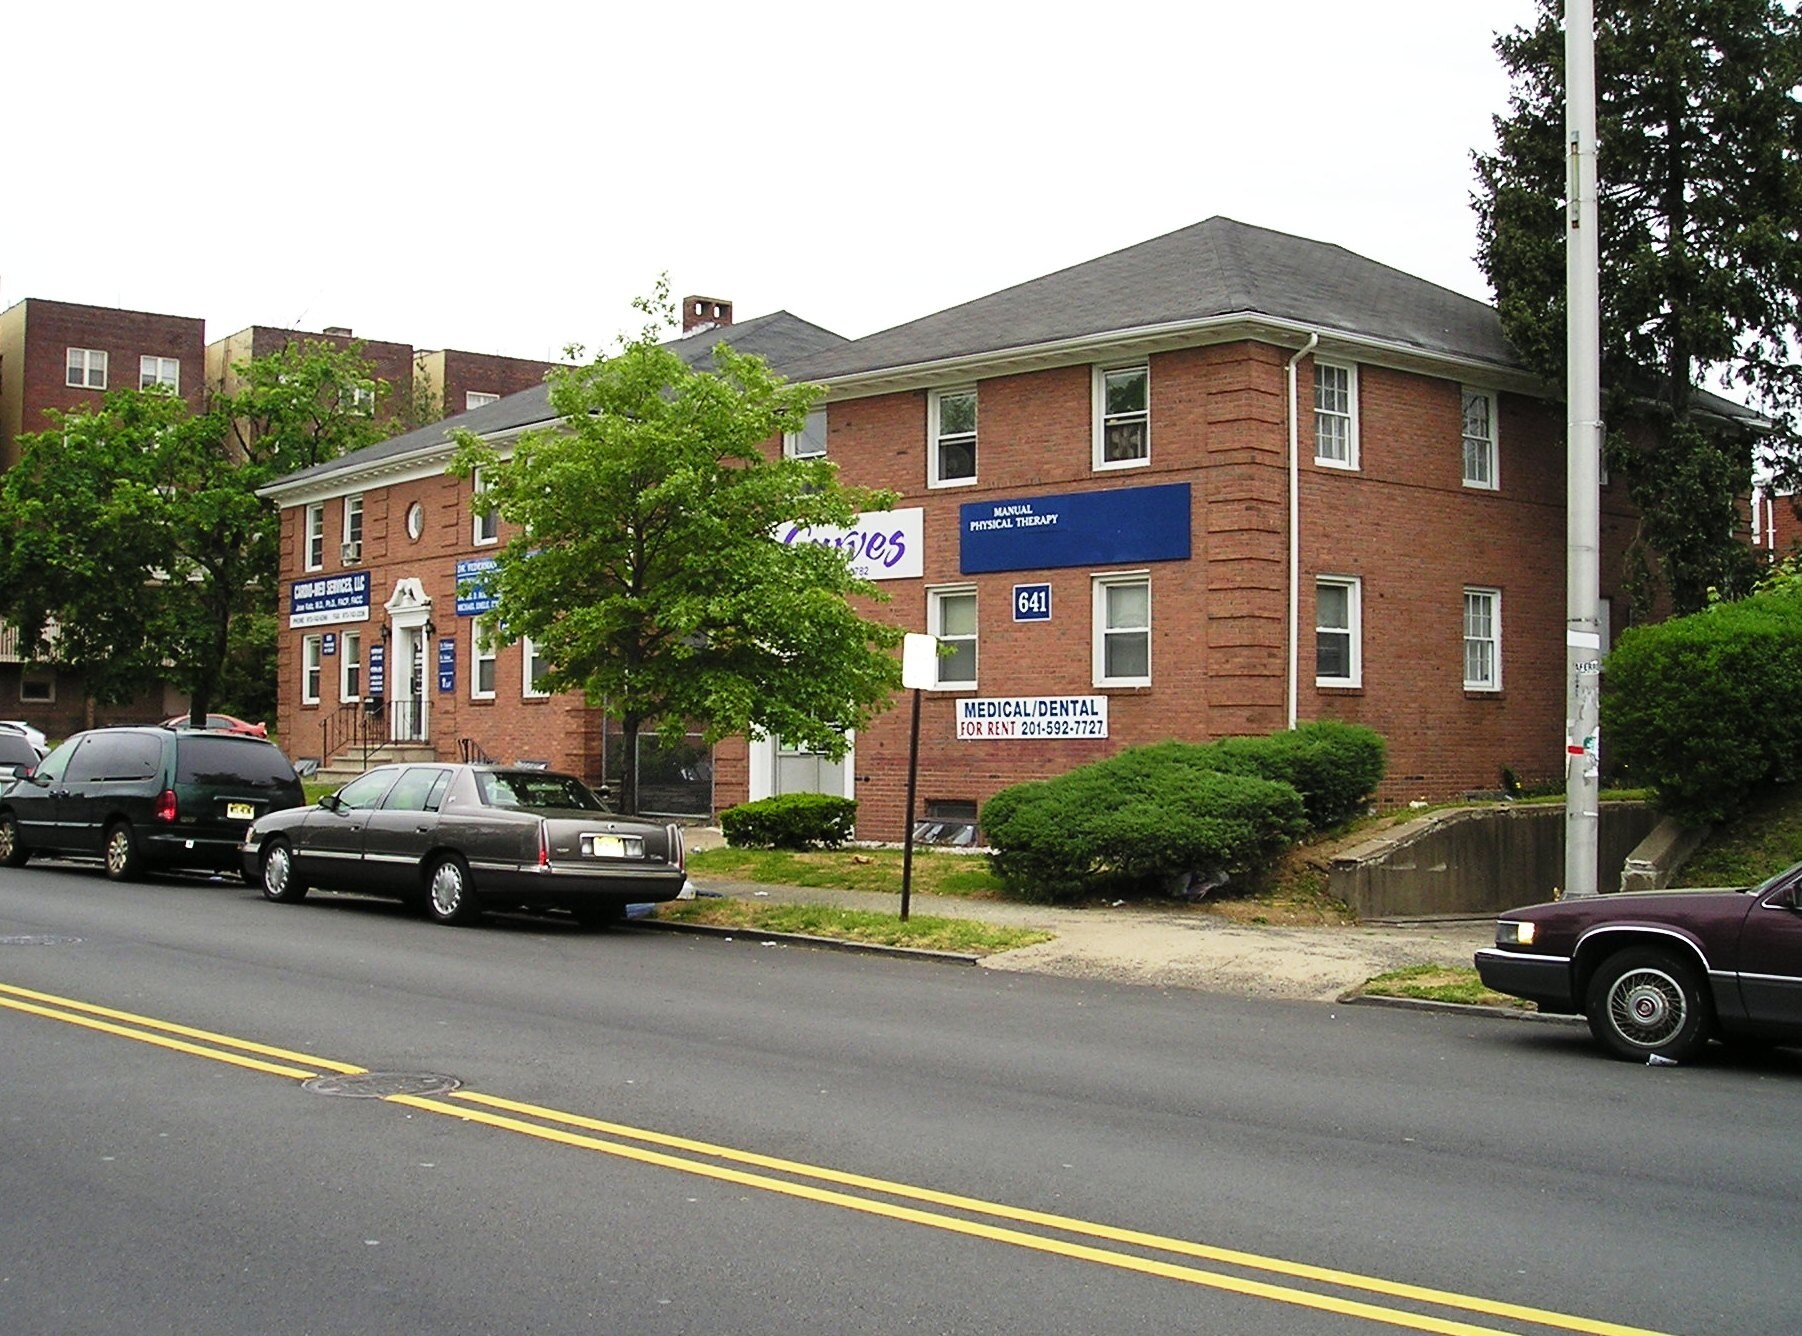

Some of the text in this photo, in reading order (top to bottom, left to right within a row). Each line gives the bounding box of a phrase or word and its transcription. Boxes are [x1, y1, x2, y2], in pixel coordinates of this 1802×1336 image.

[993, 504, 1033, 517] MANUAL
[970, 514, 1058, 531] PHYSICAL THERAPY
[1018, 591, 1047, 613] 641
[964, 699, 1099, 718] MEDICAL/DENTAL
[960, 720, 1104, 736] FOR RENT 201-592-7727
